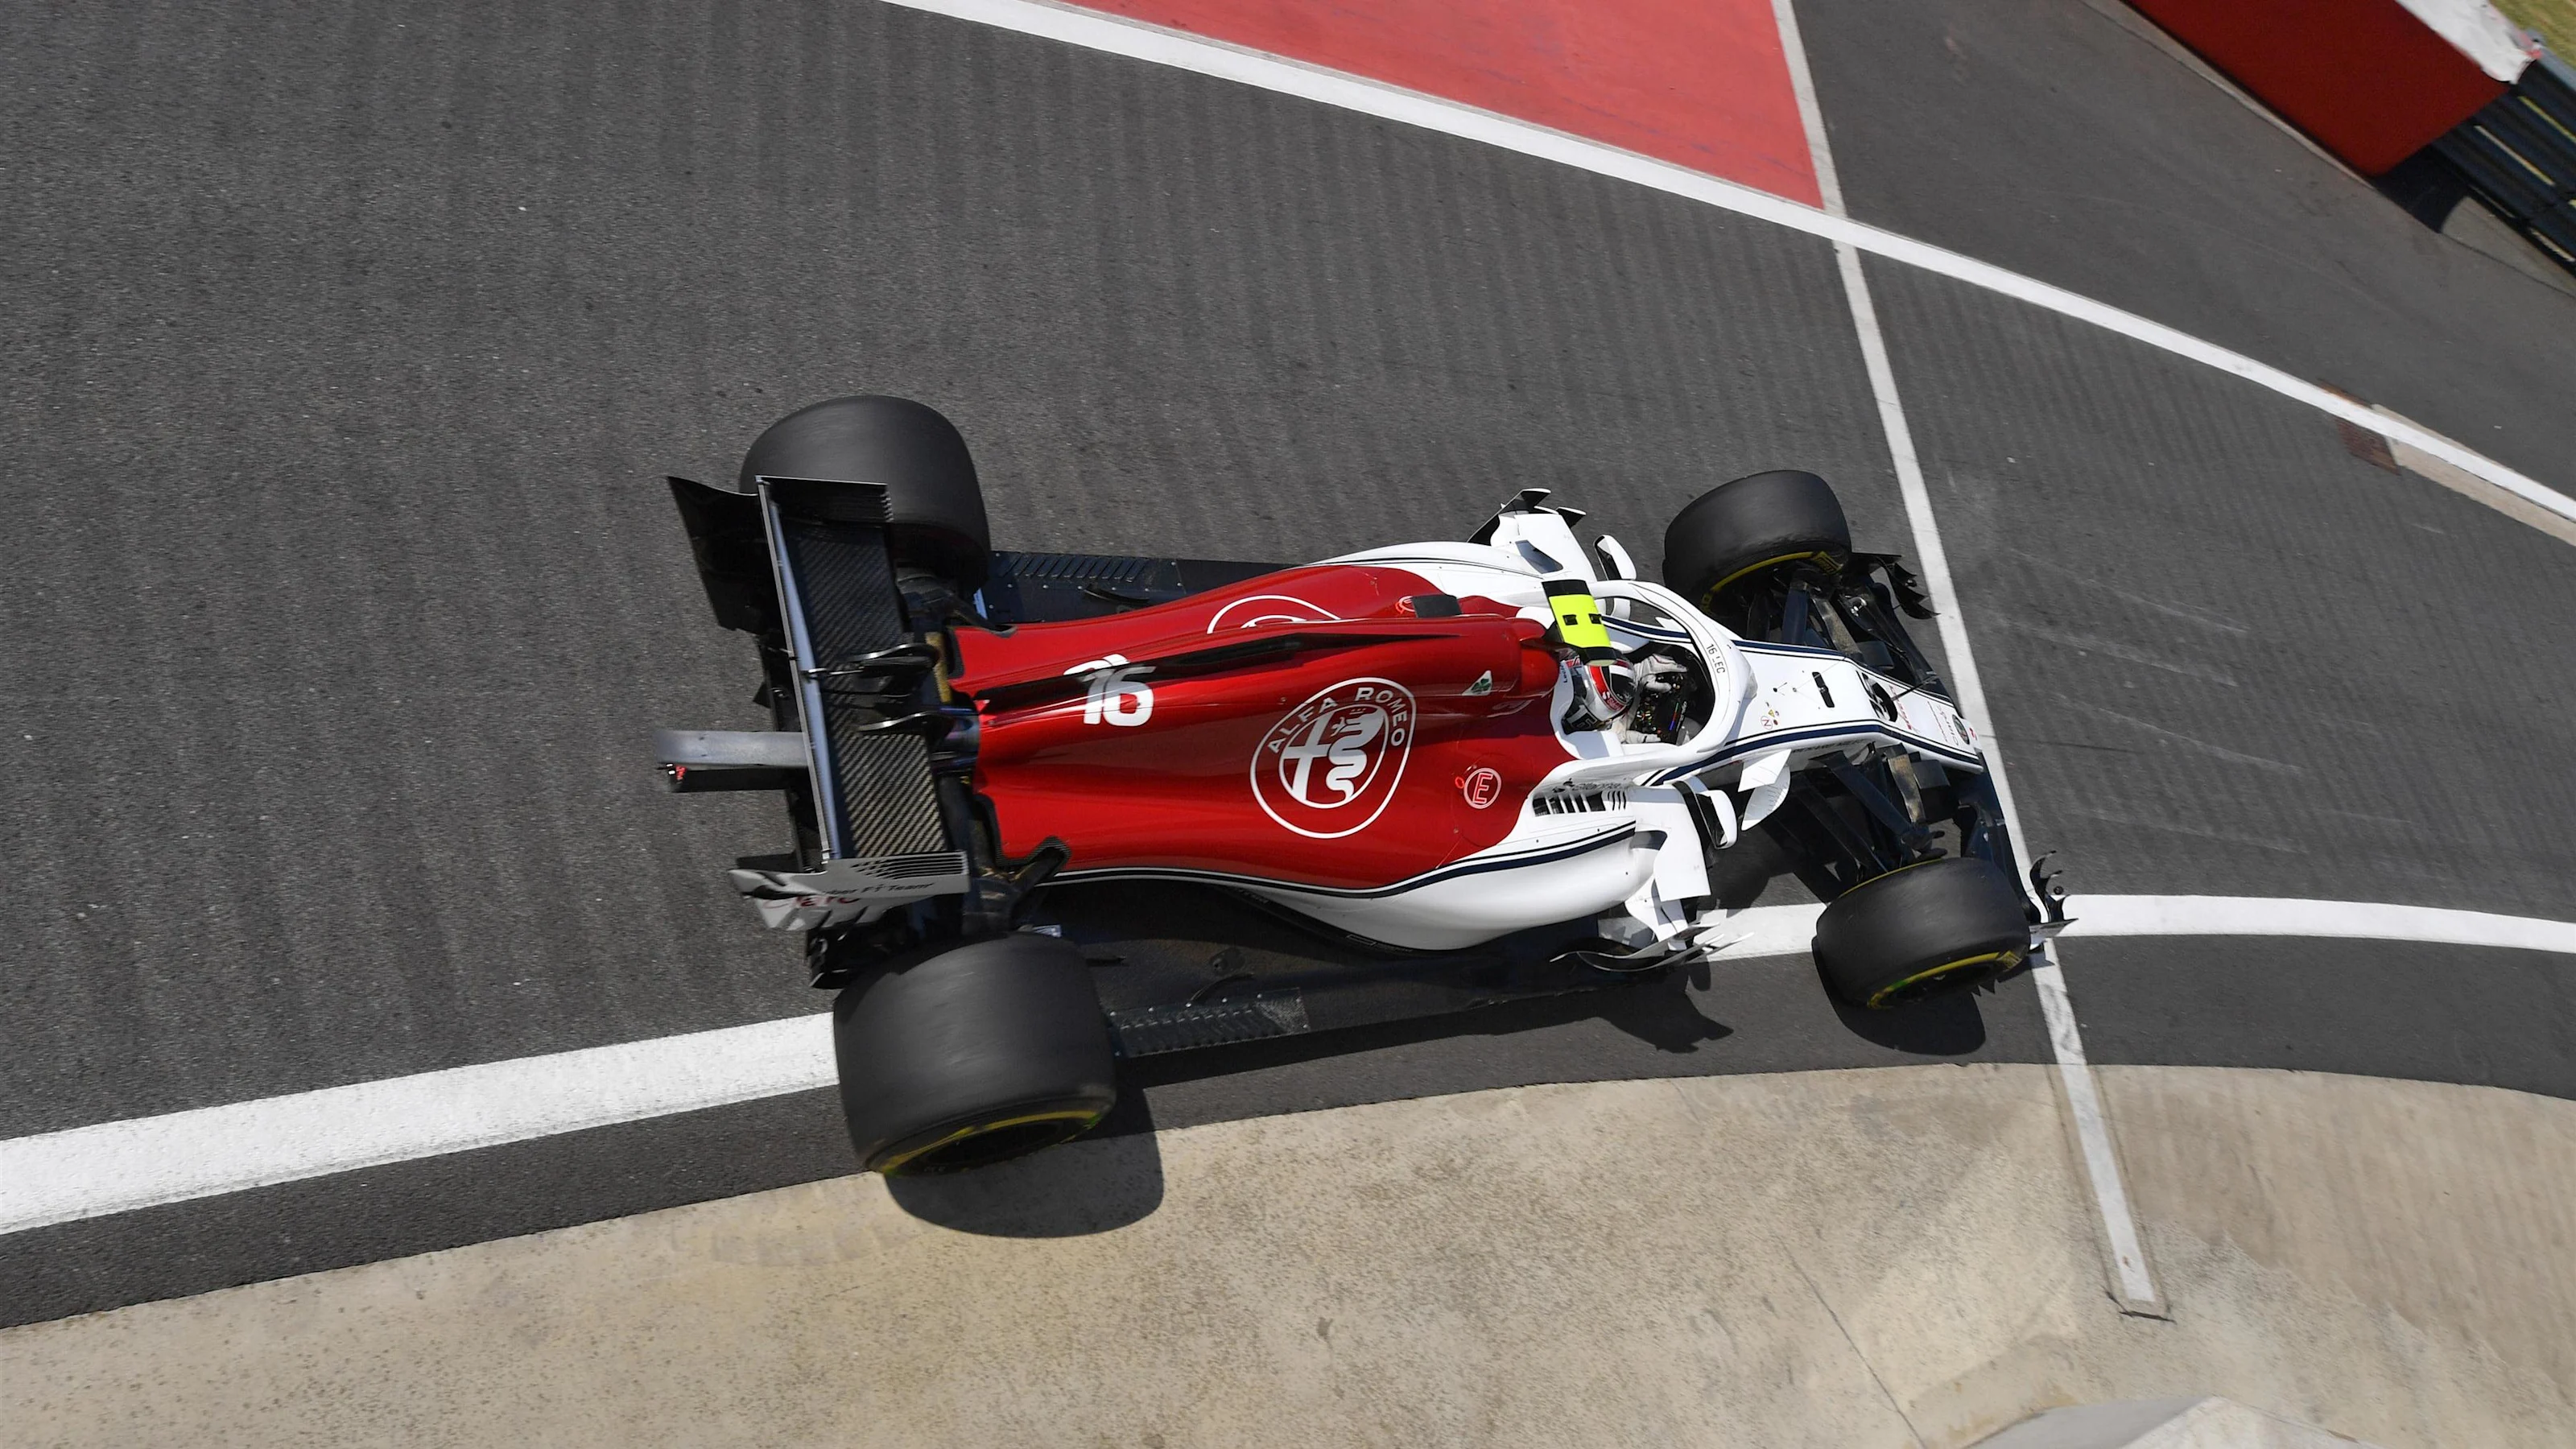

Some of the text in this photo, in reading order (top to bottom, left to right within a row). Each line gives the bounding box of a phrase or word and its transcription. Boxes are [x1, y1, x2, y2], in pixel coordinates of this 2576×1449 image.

[1707, 643, 1718, 655] 16
[1080, 666, 1156, 727] 16
[1268, 687, 1408, 754] ALFA ROMEO
[1472, 772, 1494, 804] E
